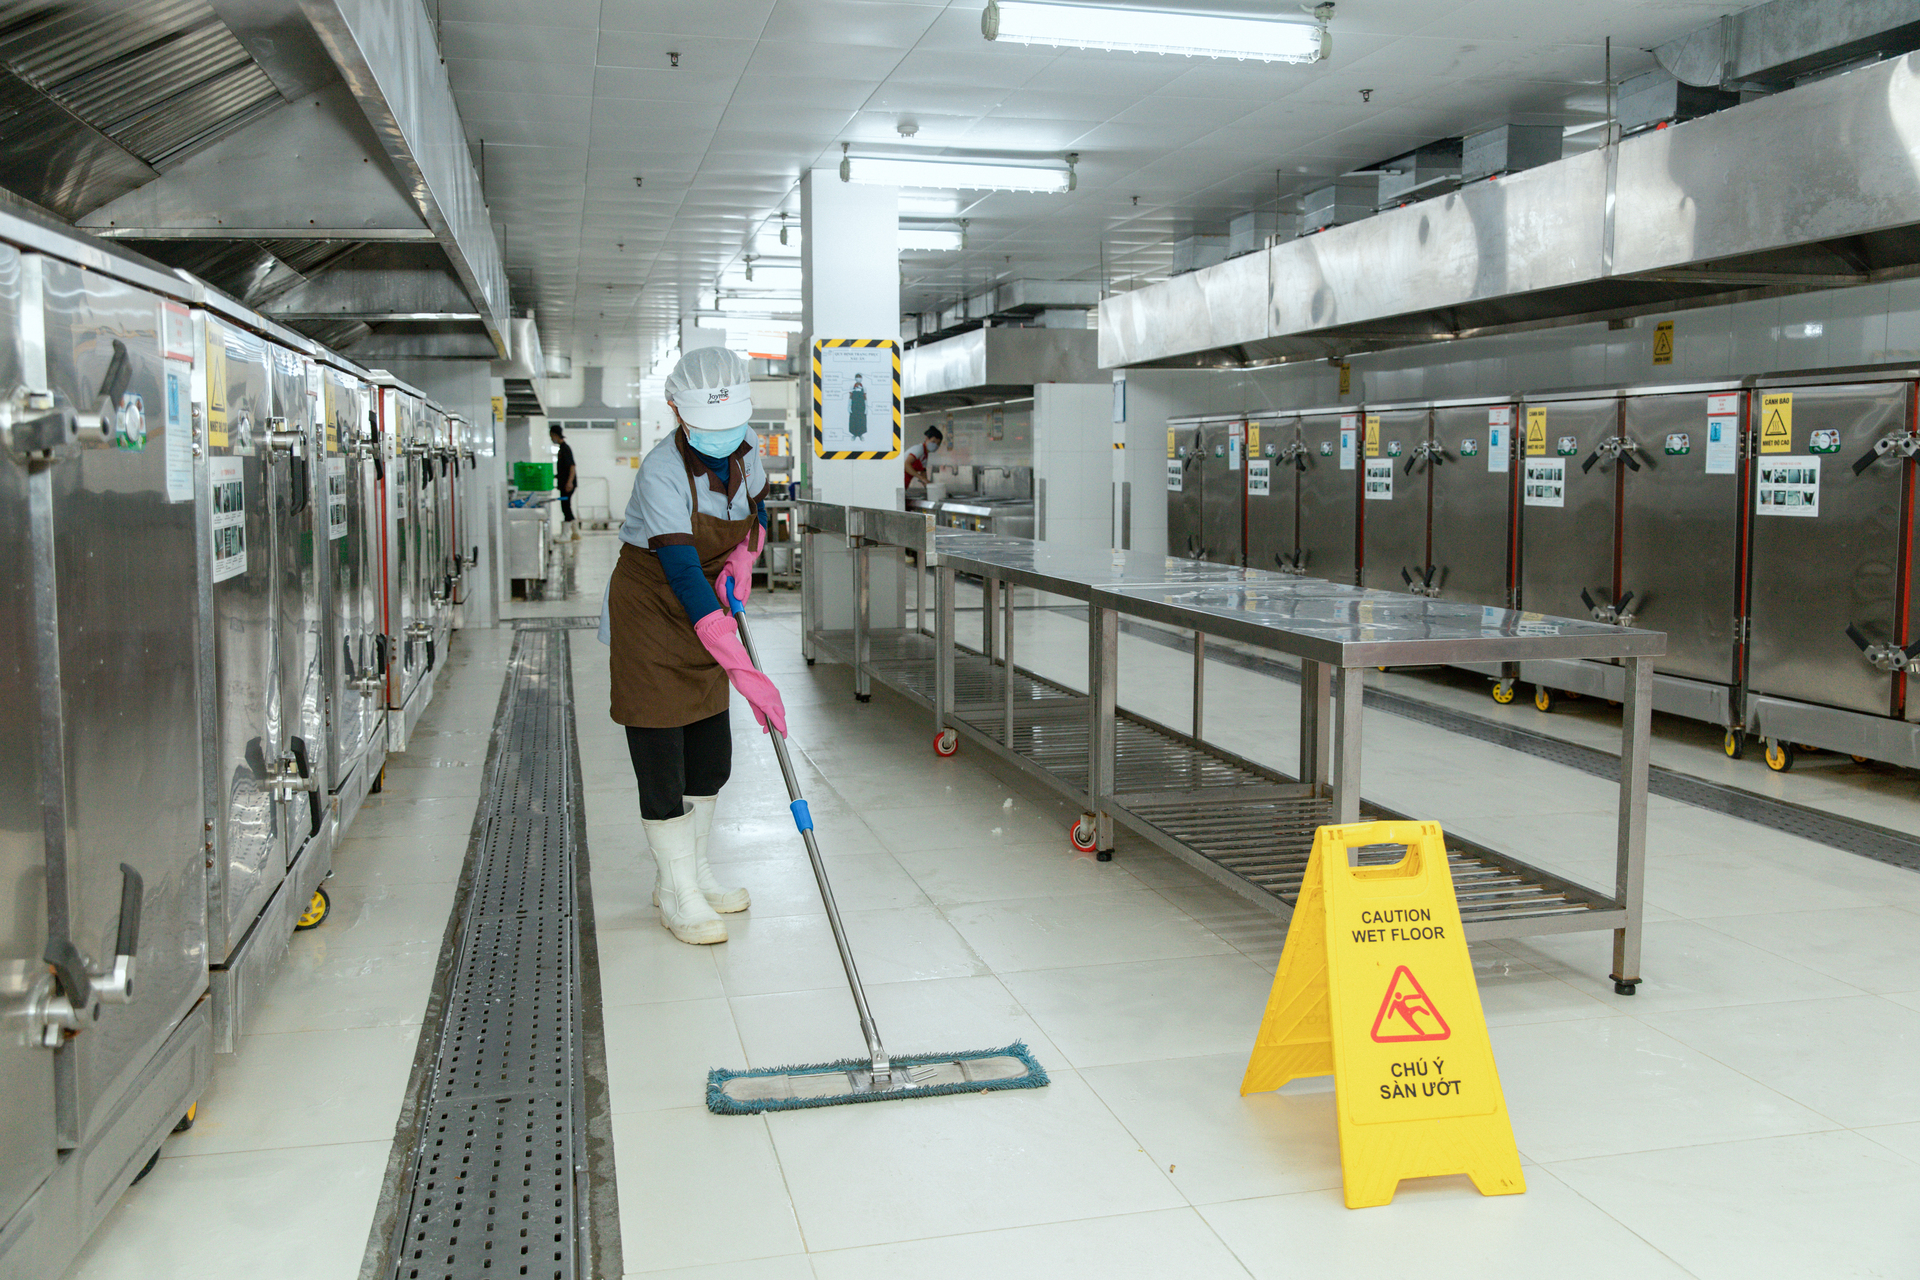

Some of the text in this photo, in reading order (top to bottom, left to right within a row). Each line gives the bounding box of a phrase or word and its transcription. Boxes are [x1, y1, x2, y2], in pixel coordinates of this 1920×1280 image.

[1361, 908, 1431, 924] CAUTION
[1352, 926, 1445, 943] WET FLOOR
[1391, 1056, 1444, 1077] CHÚ Ý
[1380, 1077, 1461, 1099] SÀN ƯỚT
